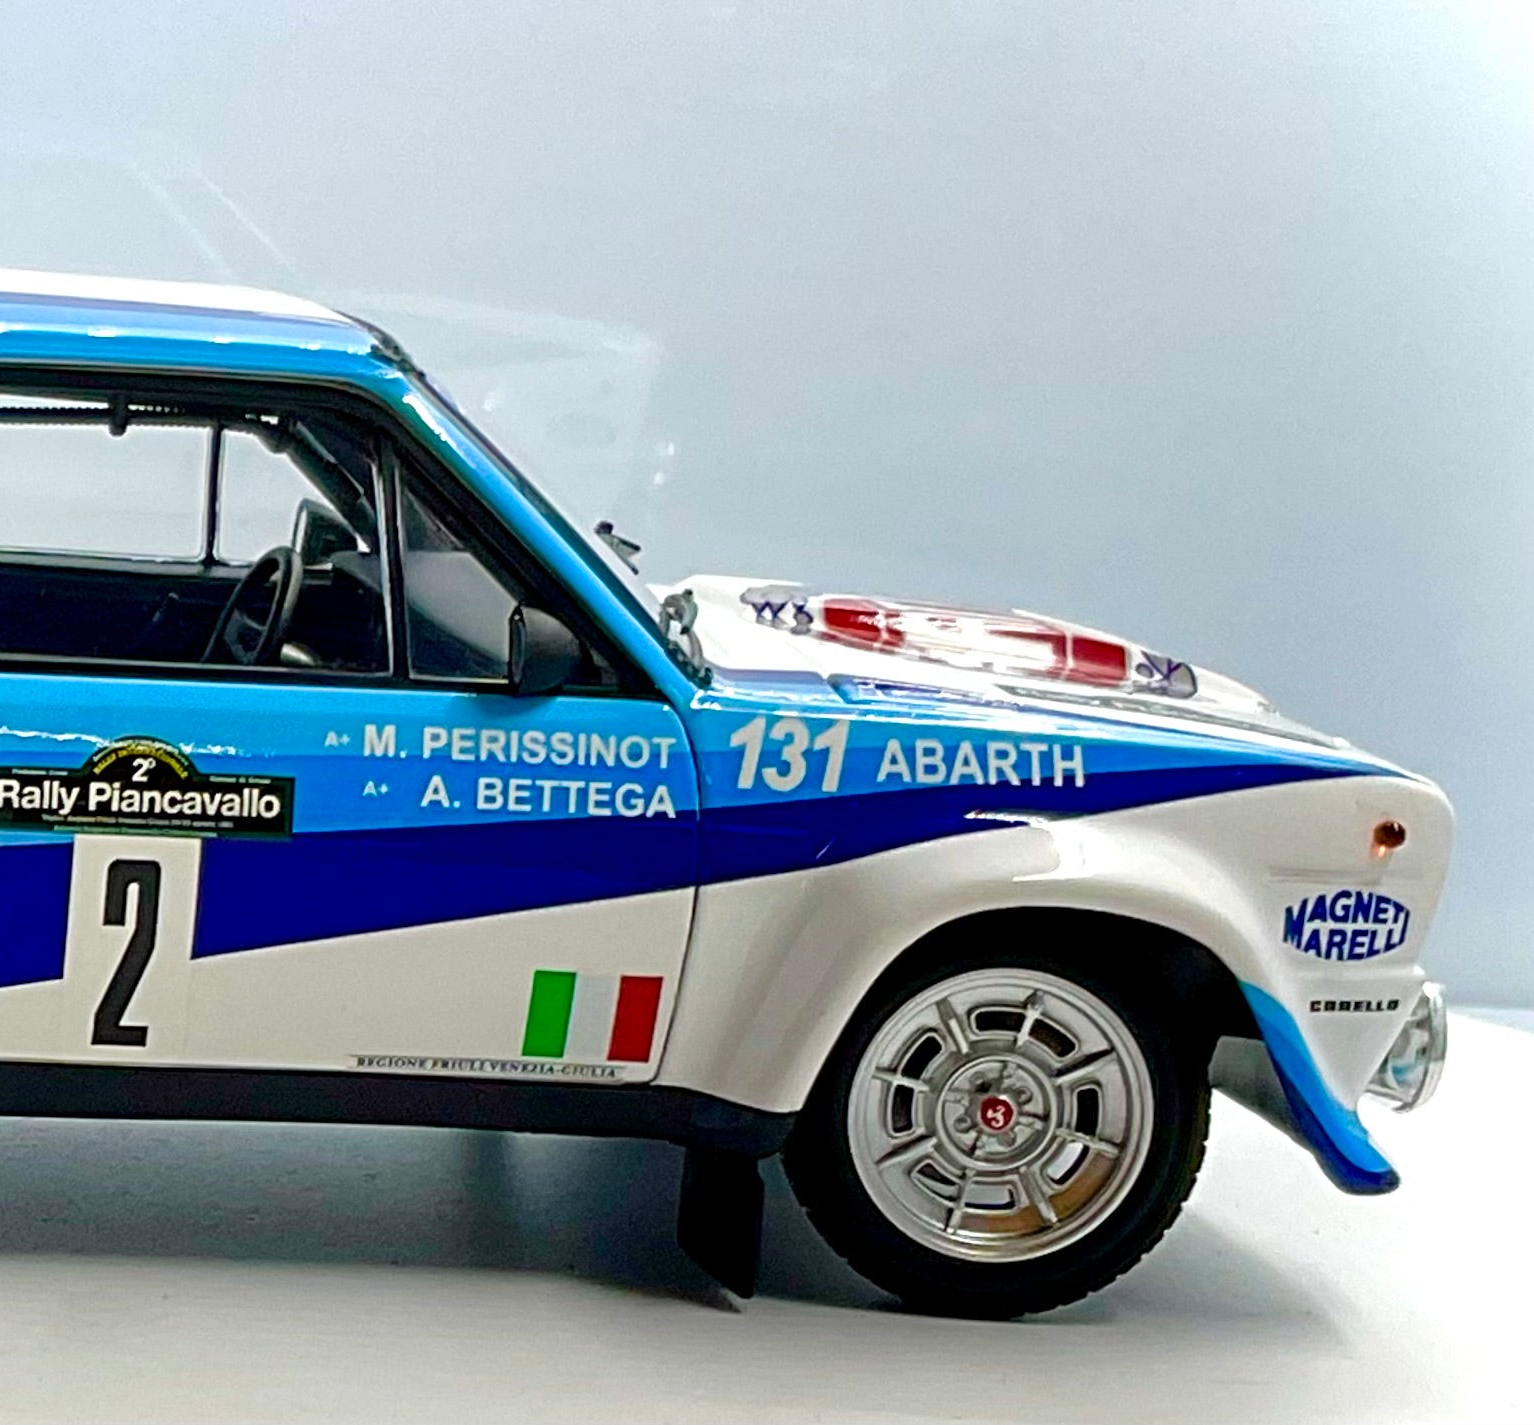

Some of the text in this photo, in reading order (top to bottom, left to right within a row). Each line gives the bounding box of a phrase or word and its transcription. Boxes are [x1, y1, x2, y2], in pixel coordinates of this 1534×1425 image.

[323, 724, 677, 769] A+ M. PERISSINOT
[729, 715, 1086, 793] 131 ABARTH
[88, 781, 282, 819] Piancavallo
[362, 774, 677, 819] A+ A. BETTEGA
[90, 858, 161, 1047] 2
